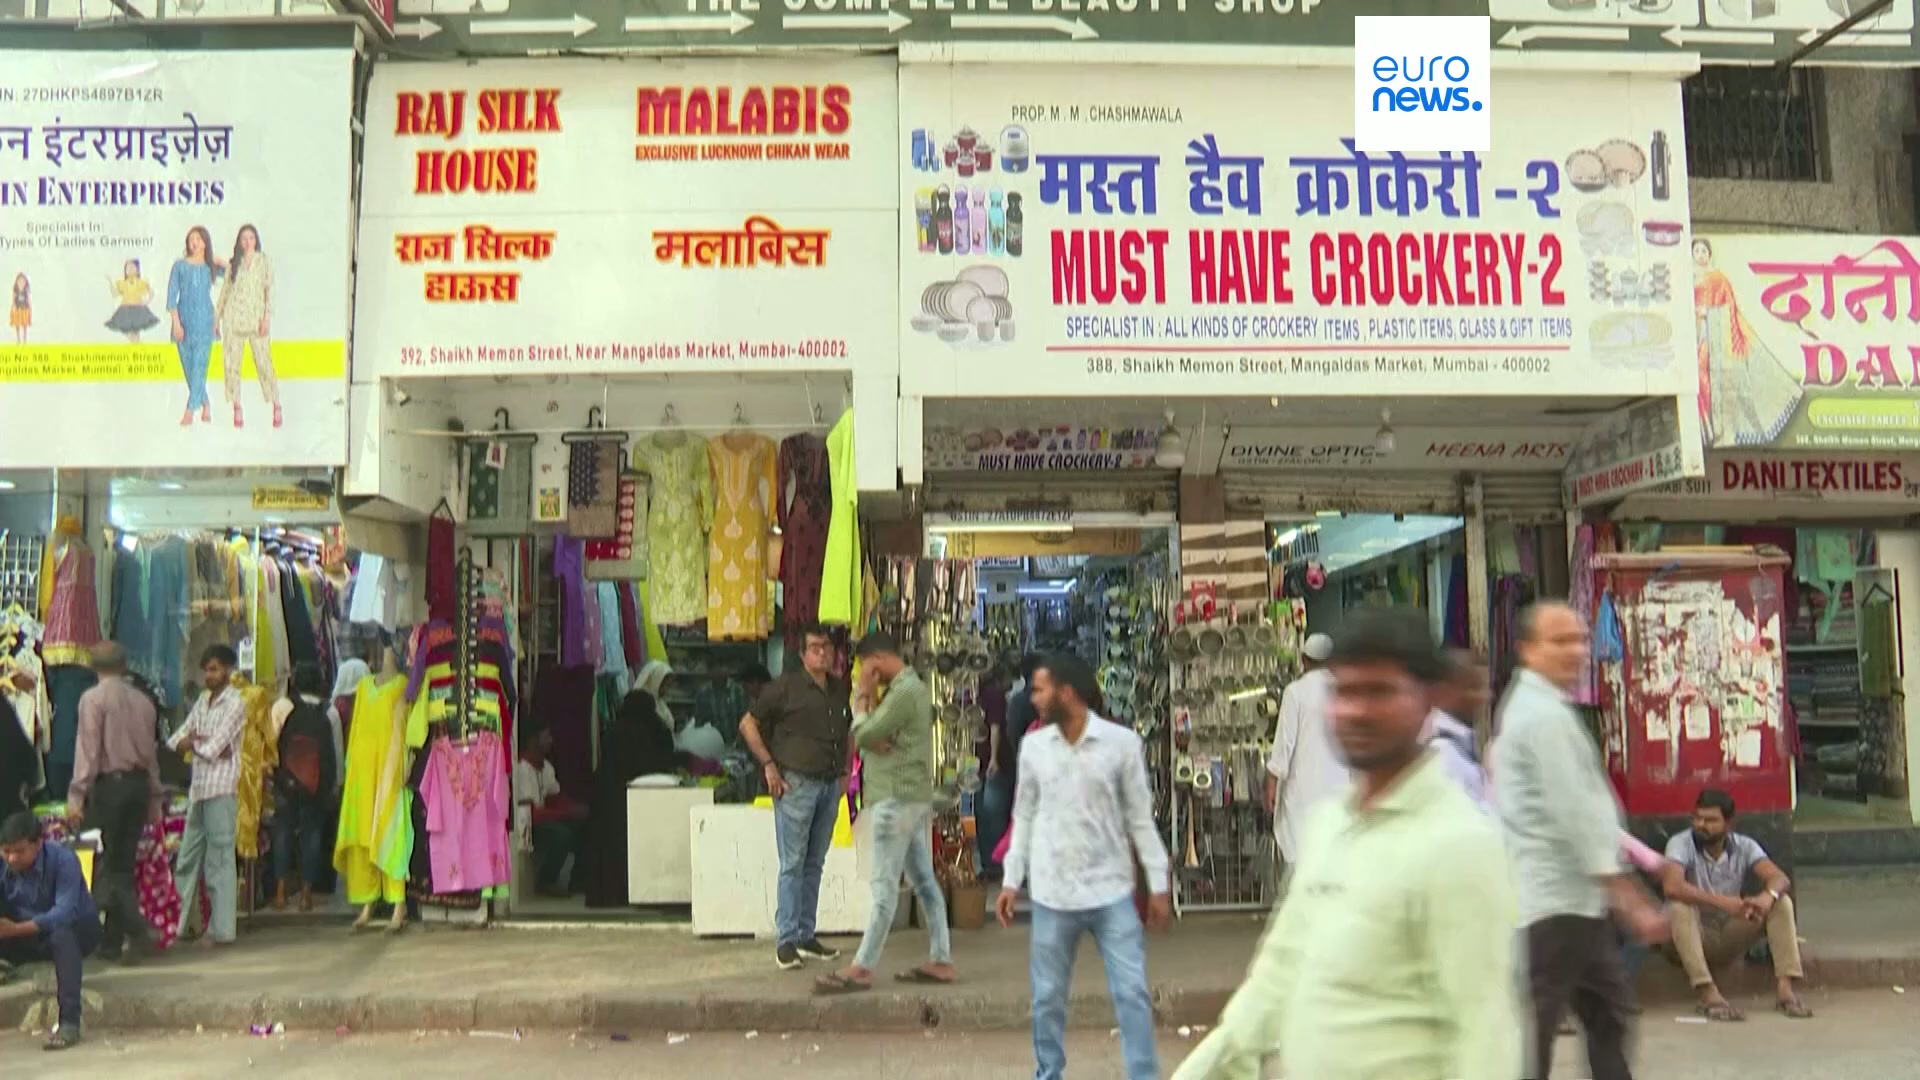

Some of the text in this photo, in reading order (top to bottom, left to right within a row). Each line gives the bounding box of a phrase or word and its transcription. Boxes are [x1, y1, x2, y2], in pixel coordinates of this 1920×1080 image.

[395, 88, 563, 140] RAJ SILK
[635, 85, 853, 137] MALABIS
[635, 144, 850, 161] EXCLUSIVE LUCKNOWI CHIKAN WEAR
[415, 148, 538, 194] HOUSE
[1036, 156, 1160, 214] मस्त
[1185, 133, 1264, 216] हैव
[38, 176, 225, 206] ENTERPRISES
[26, 222, 85, 236] Specialist
[55, 236, 96, 249] Ladies
[100, 236, 154, 248] Garment
[652, 214, 832, 269] मलाबिस
[395, 225, 557, 264] राज सिल्क
[1051, 229, 1566, 307] MUST HAVE CROCKERY-2
[1066, 316, 1138, 338] SPECIALIST
[1142, 317, 1154, 337] IN
[1165, 317, 1188, 337] ALL
[1192, 316, 1229, 337] KINDS
[1232, 316, 1248, 337] OF
[1252, 316, 1318, 338] CROCKERY
[1369, 318, 1417, 339] PLASTIC
[1459, 318, 1497, 338] GLASS
[1499, 318, 1507, 337] &
[1510, 318, 1533, 337] GIFT
[1540, 317, 1572, 337] ITEMS
[401, 347, 426, 366] 392,
[430, 345, 473, 364] Shaikh
[478, 345, 524, 361] Memon
[528, 344, 571, 362] Street,
[576, 343, 607, 360] Near
[612, 342, 680, 364] Mangaldas
[686, 342, 734, 361] Market,
[1087, 358, 1117, 374] 388,
[1122, 357, 1174, 374] Shaikh
[1180, 358, 1234, 373] Memon
[1239, 357, 1287, 374] Street,
[1291, 357, 1370, 376] Mangaldas
[1375, 357, 1427, 373] Market,
[1433, 357, 1489, 372] Mumbai
[1502, 357, 1551, 372] 400002
[1801, 343, 1920, 386] DA
[978, 454, 1011, 471] MUST
[1014, 454, 1044, 470] HAVE
[1231, 445, 1302, 457] DIVINE
[1425, 443, 1568, 457] MEENA ARTS
[1723, 460, 1785, 490] DANI
[1791, 461, 1902, 491] TEXTILES
